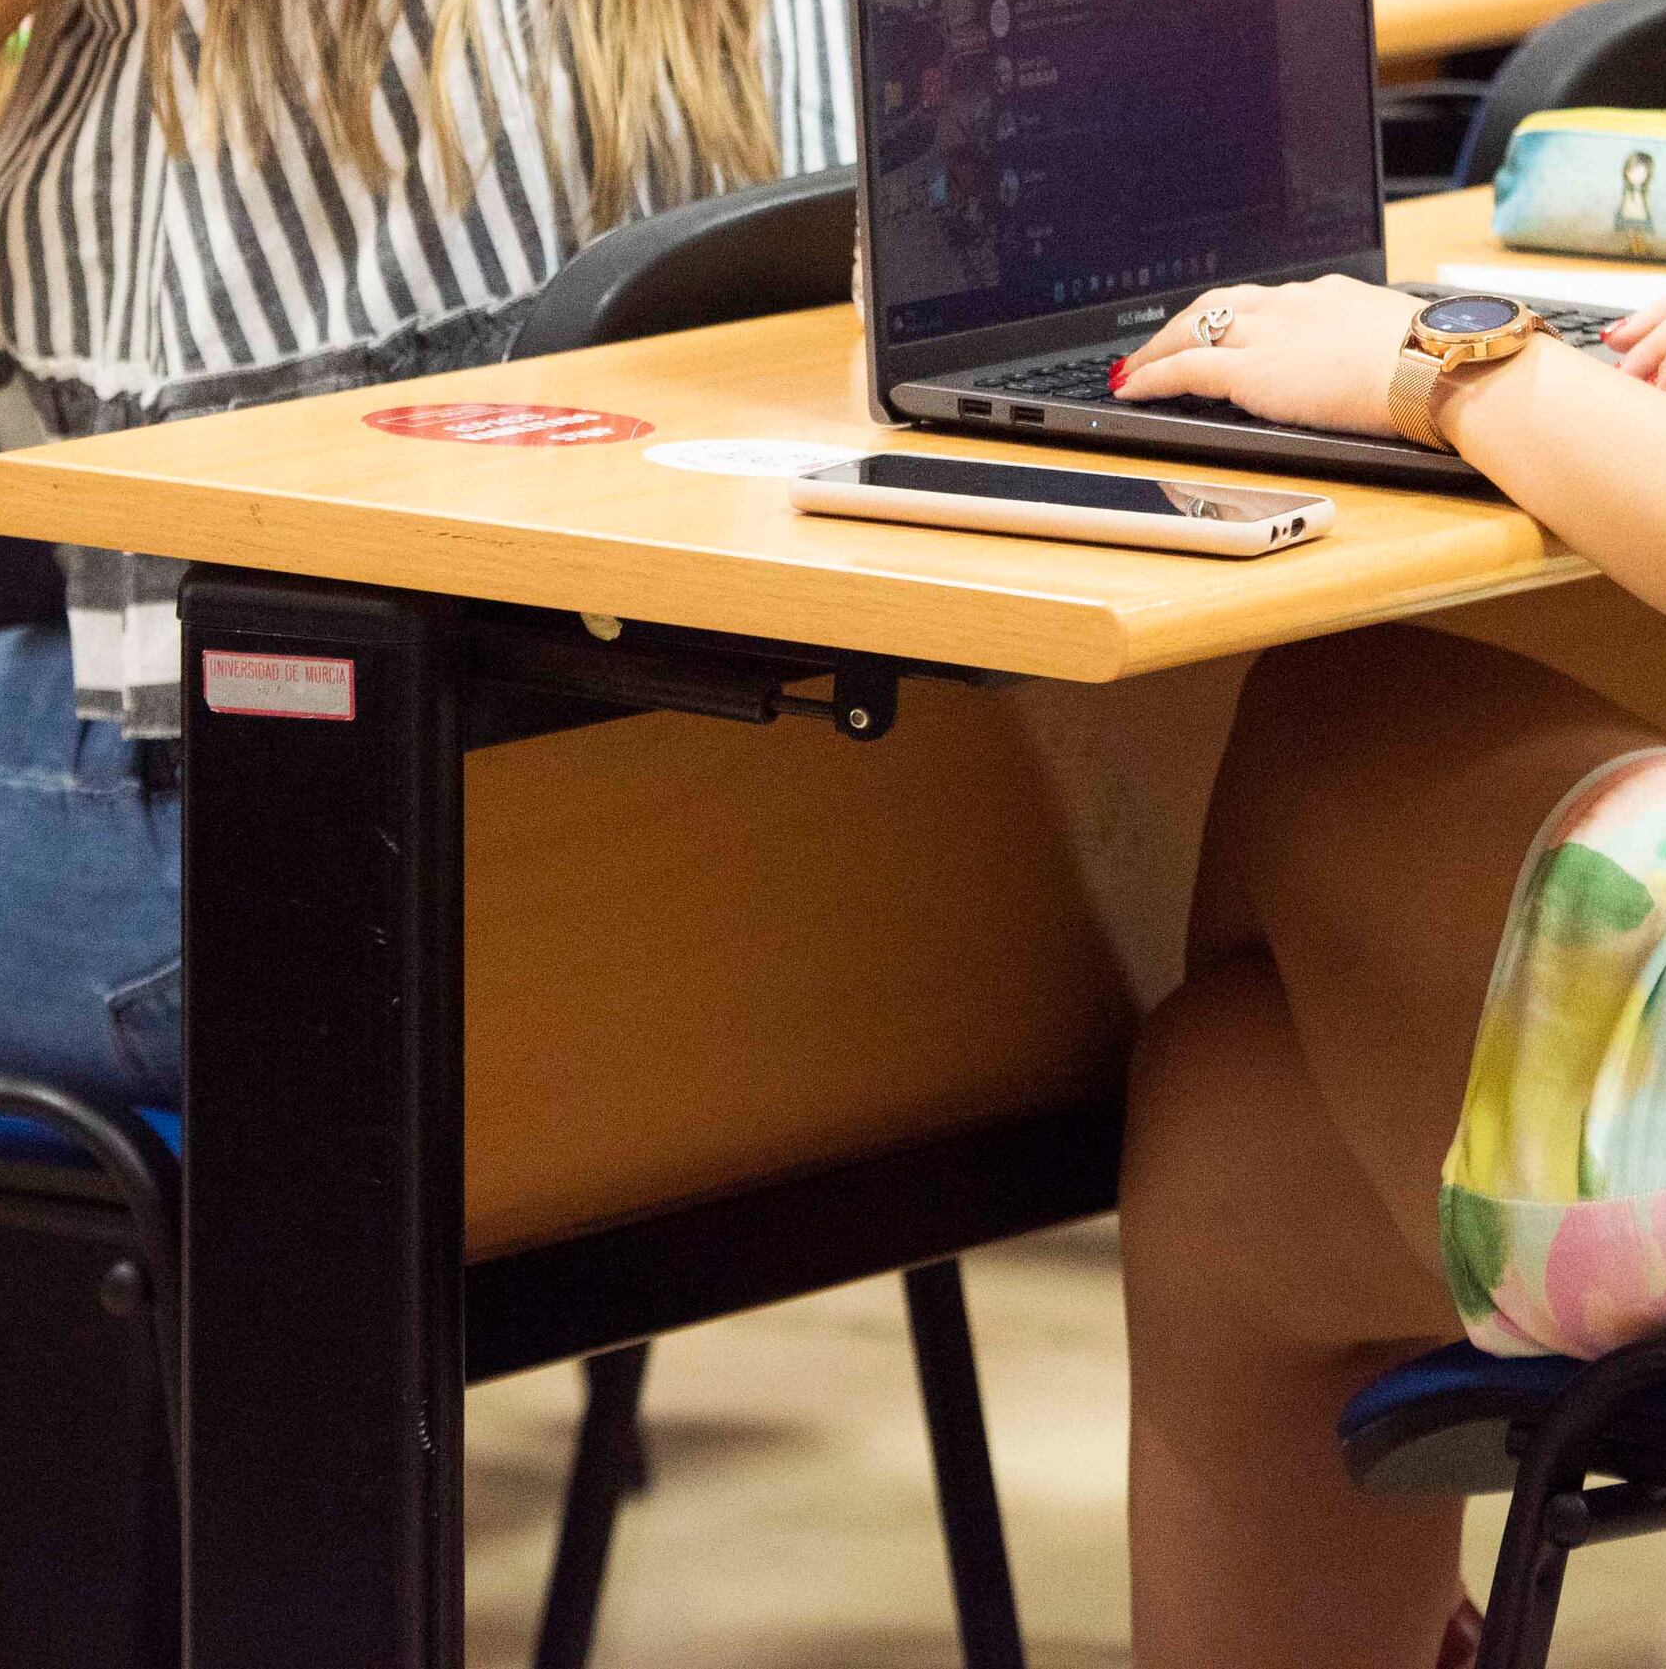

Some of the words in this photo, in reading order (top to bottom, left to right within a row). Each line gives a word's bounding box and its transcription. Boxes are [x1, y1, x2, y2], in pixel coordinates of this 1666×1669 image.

[209, 659, 280, 681] UNIVERSIDAD
[285, 665, 299, 683] DE
[305, 666, 347, 685] MURCIA
